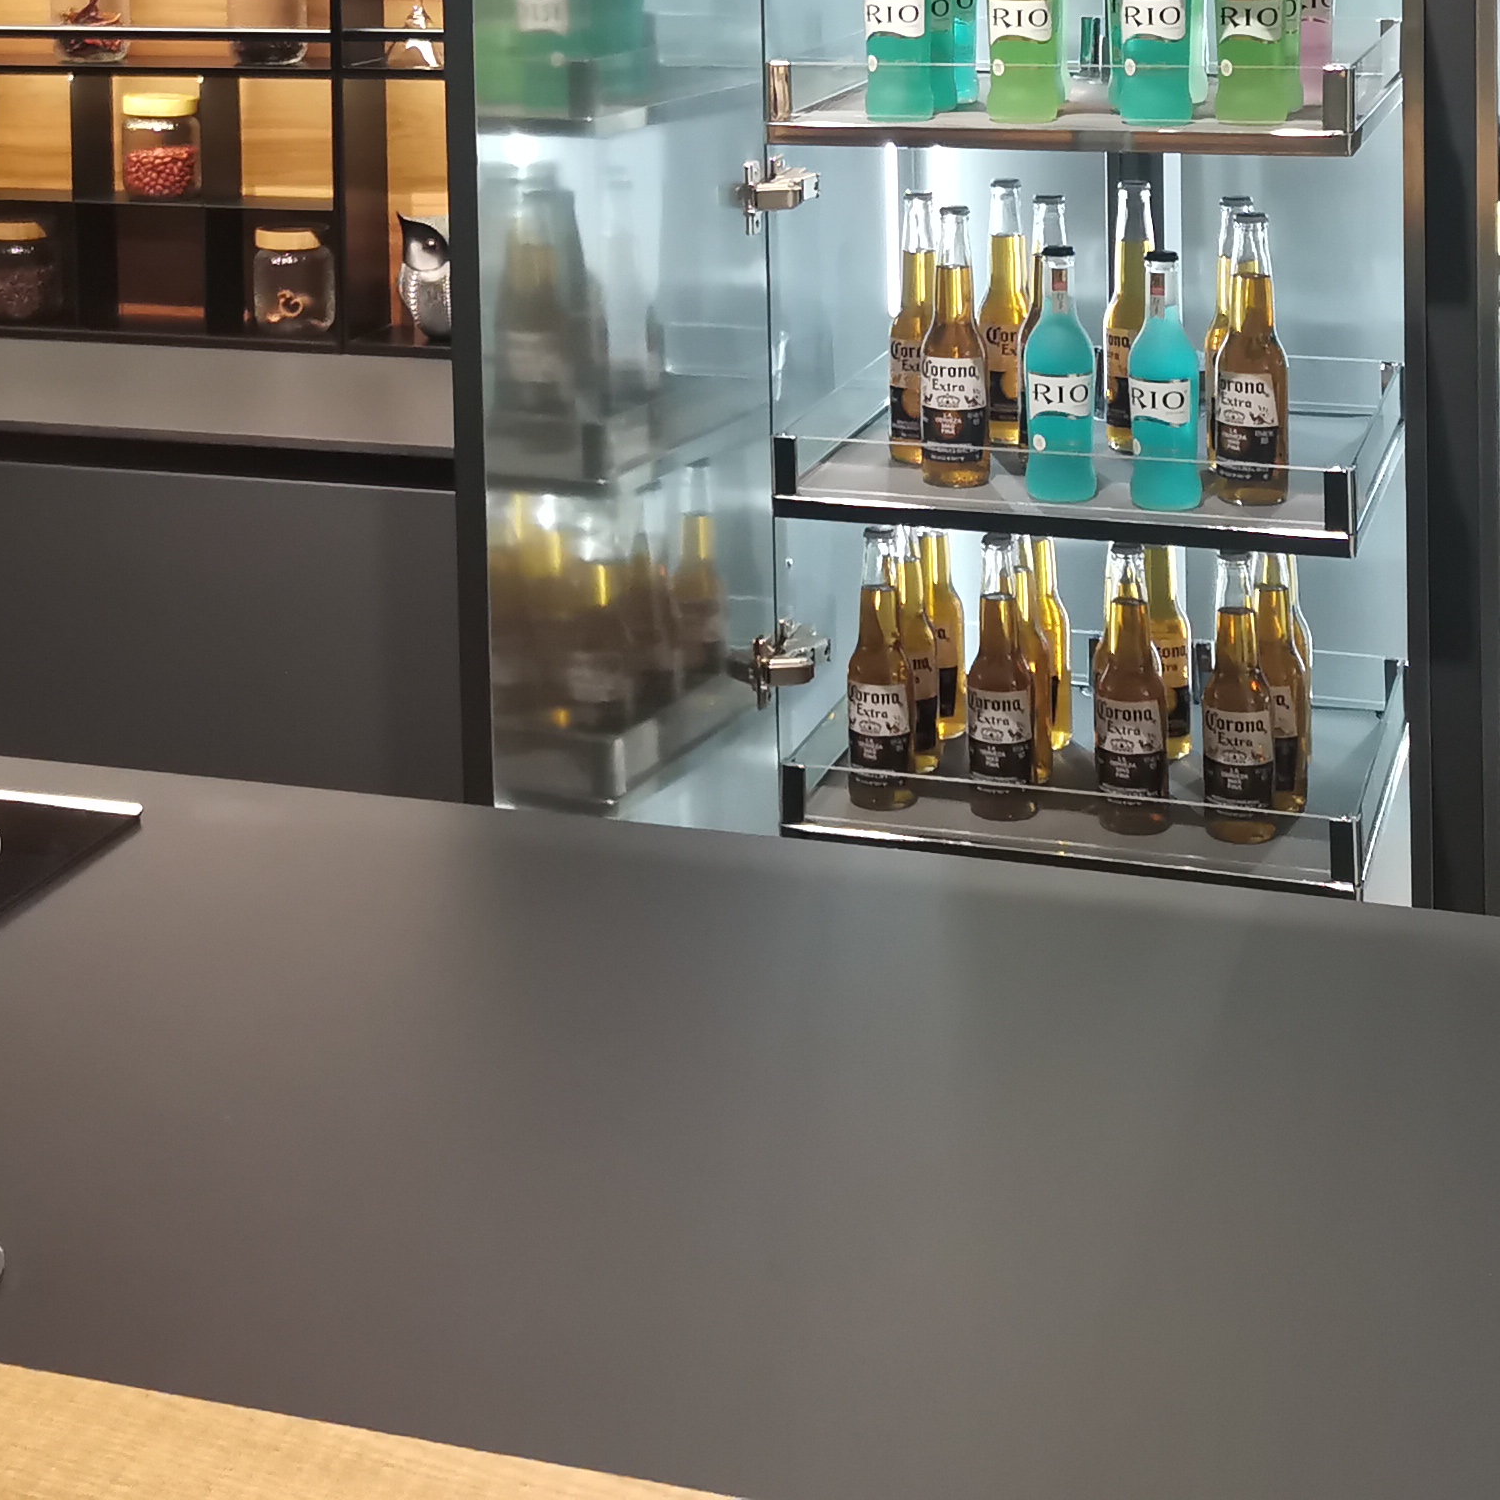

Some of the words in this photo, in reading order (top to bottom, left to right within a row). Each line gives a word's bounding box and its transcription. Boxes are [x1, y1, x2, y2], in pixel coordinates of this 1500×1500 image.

[866, 4, 919, 25] RIO
[992, 8, 1048, 28] RIO
[1124, 6, 1181, 27] RIO
[1220, 6, 1278, 28] RIO
[922, 360, 980, 381] Corona
[932, 379, 965, 393] Extra
[1032, 383, 1089, 405] RIO
[1219, 379, 1270, 398] orona
[1131, 386, 1185, 410] RIO
[850, 684, 904, 707] Corona
[968, 691, 1025, 714] Corona
[857, 702, 888, 719] Extra
[1097, 701, 1157, 724] Corona
[1107, 719, 1141, 737] Extra
[1205, 709, 1268, 735] Corona
[1217, 731, 1254, 748] Extra
